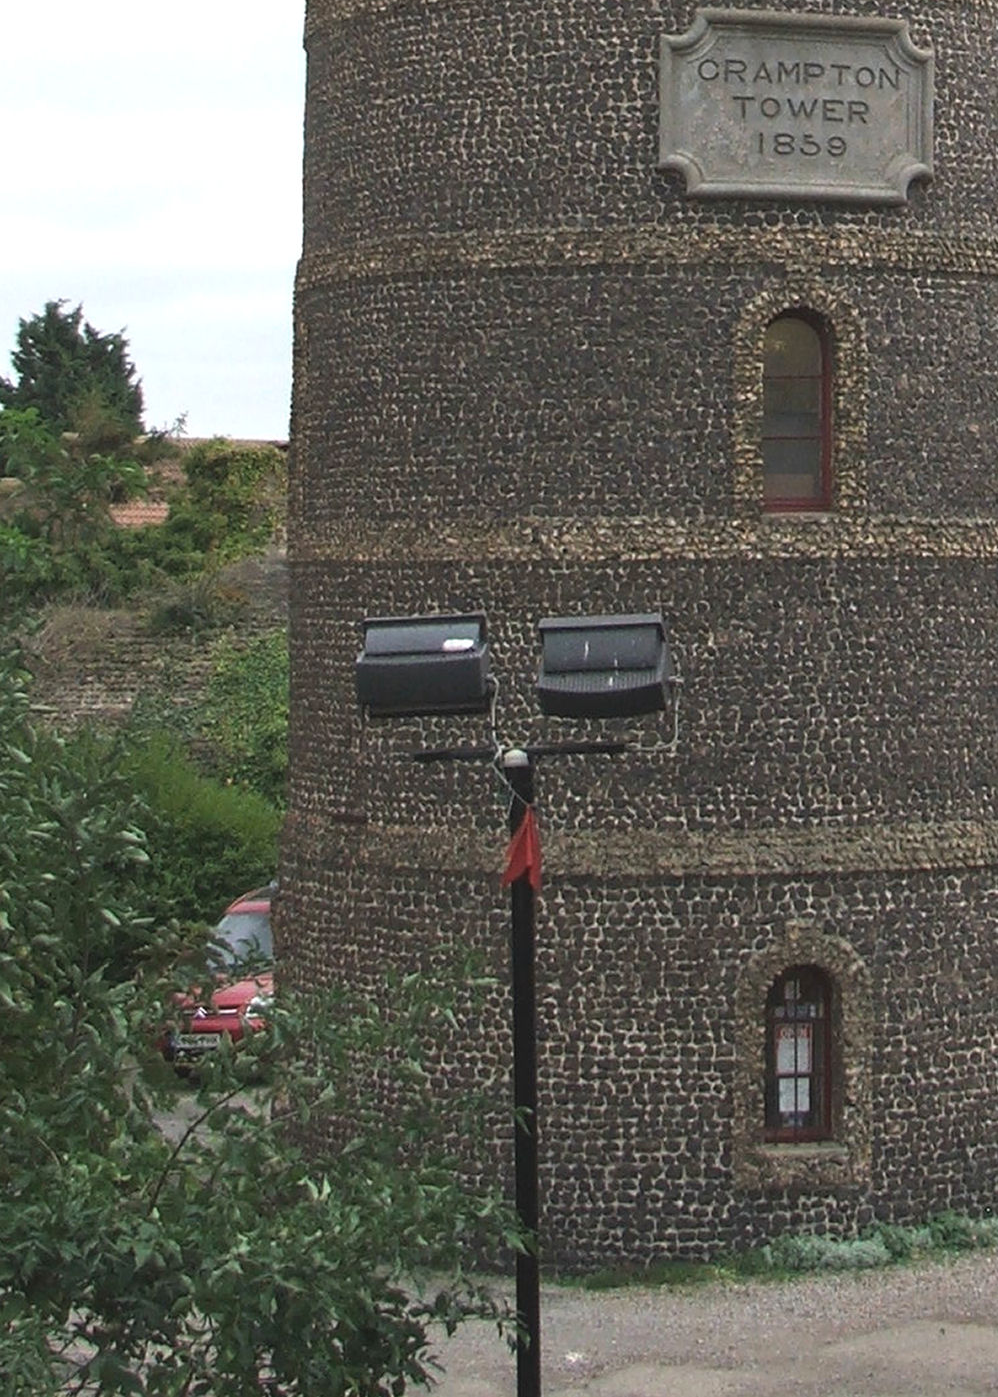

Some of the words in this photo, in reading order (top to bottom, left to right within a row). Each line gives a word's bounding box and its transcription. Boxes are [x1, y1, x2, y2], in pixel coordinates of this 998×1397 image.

[697, 58, 900, 89] CRAMPTON
[732, 96, 869, 124] TOWER
[757, 132, 848, 156] 1859
